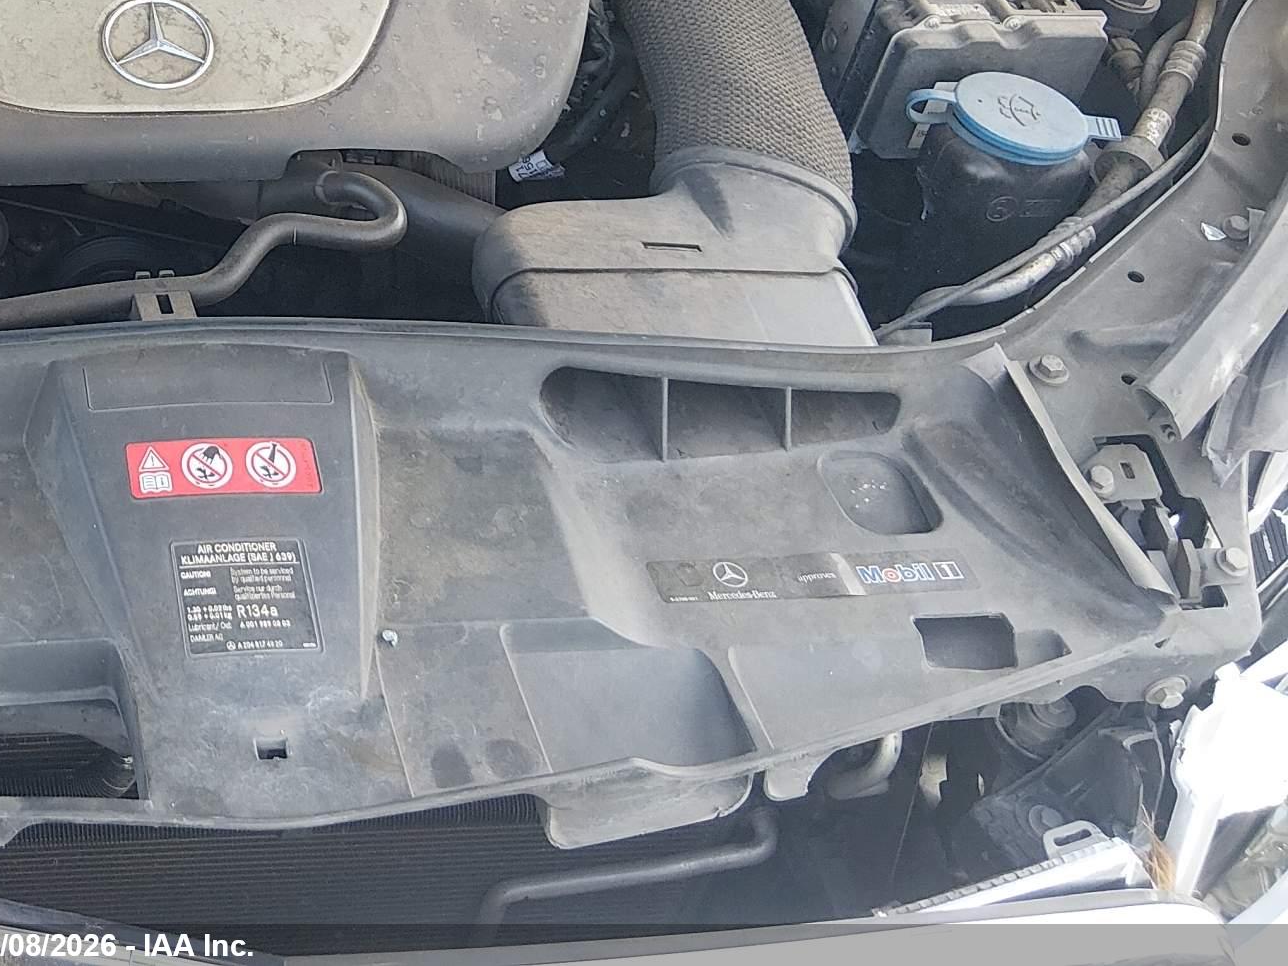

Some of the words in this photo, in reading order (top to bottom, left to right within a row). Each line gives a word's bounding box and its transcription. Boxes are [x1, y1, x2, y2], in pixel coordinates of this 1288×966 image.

[197, 543, 213, 554] AIR
[214, 542, 277, 553] CONDITIONER
[181, 553, 246, 565] KLIMAANLAGE
[247, 552, 268, 564] (SAE
[275, 552, 296, 562] 639)
[856, 562, 936, 584] Mobil
[236, 604, 279, 619] R134a
